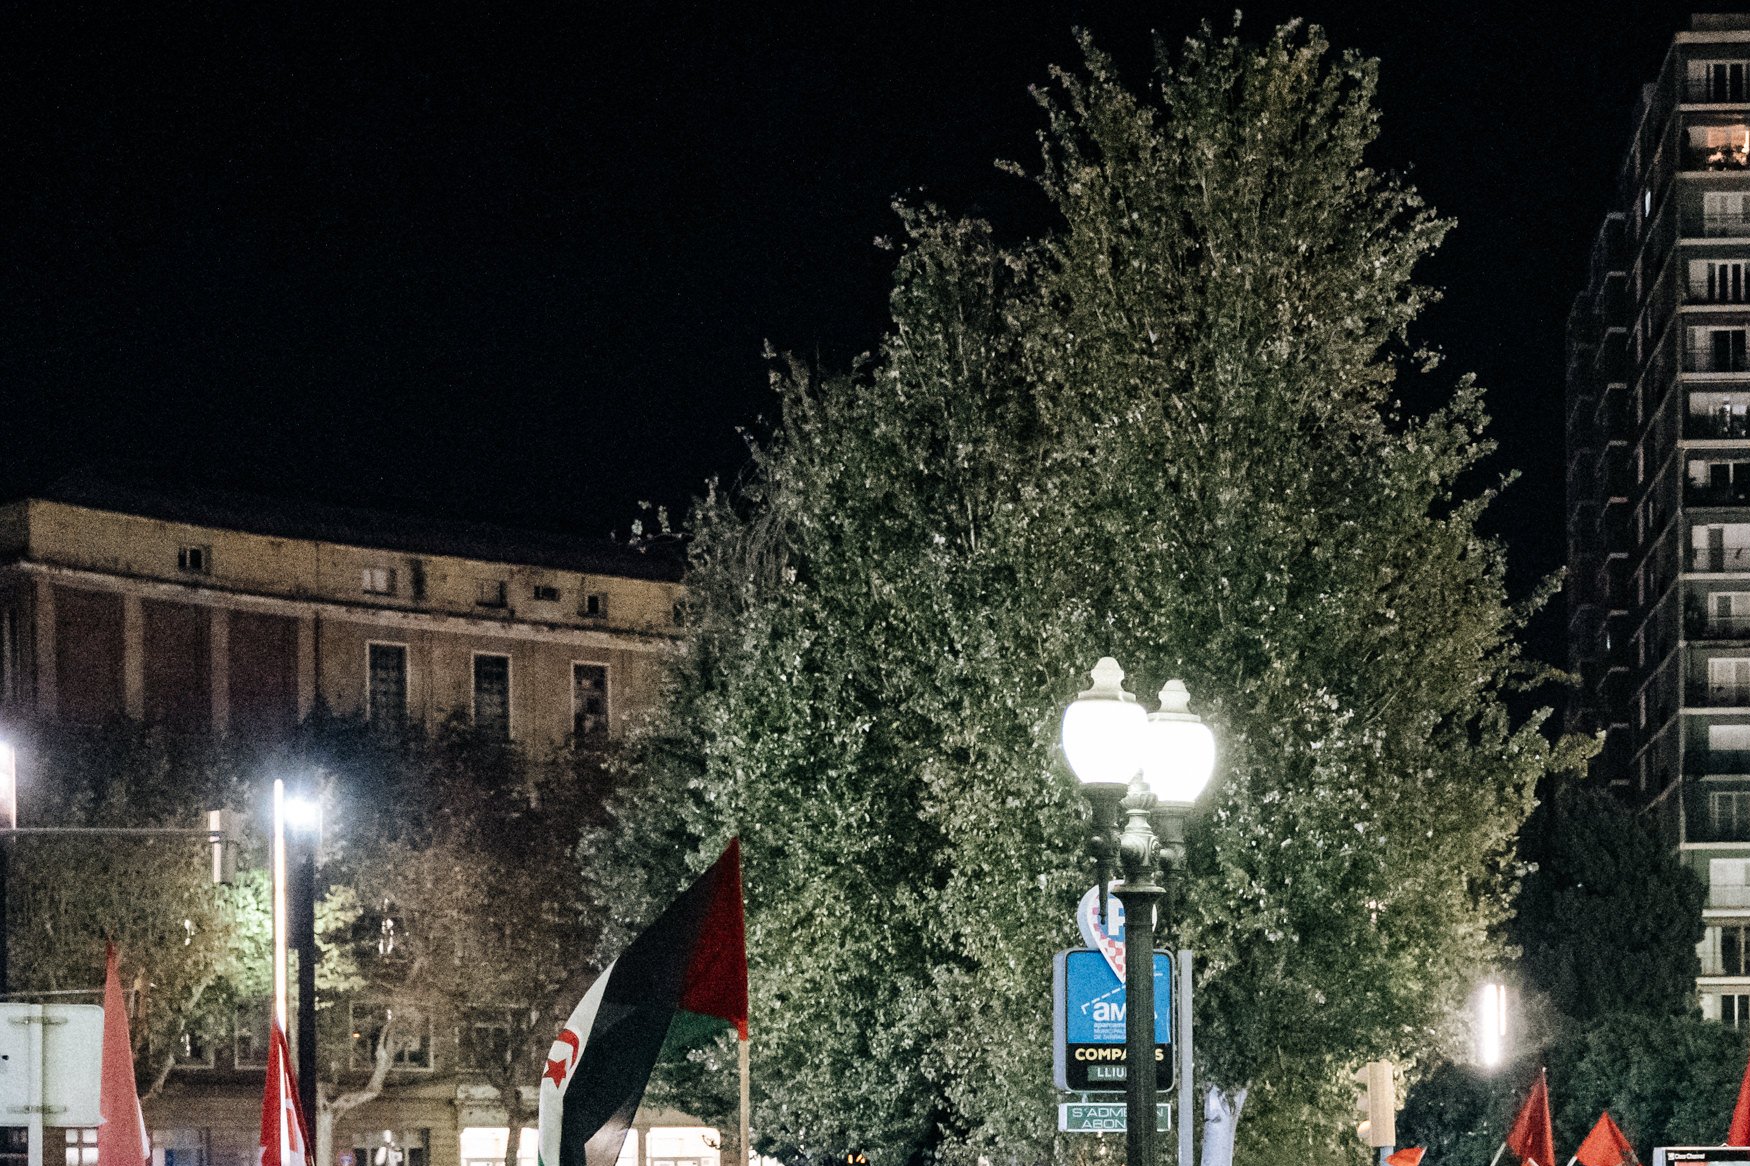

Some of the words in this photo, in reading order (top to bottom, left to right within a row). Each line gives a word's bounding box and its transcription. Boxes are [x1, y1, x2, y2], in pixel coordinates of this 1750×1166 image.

[1075, 1048, 1164, 1061] COMPS
[1097, 1068, 1127, 1077] LLIU
[1082, 1119, 1127, 1128] ABON
